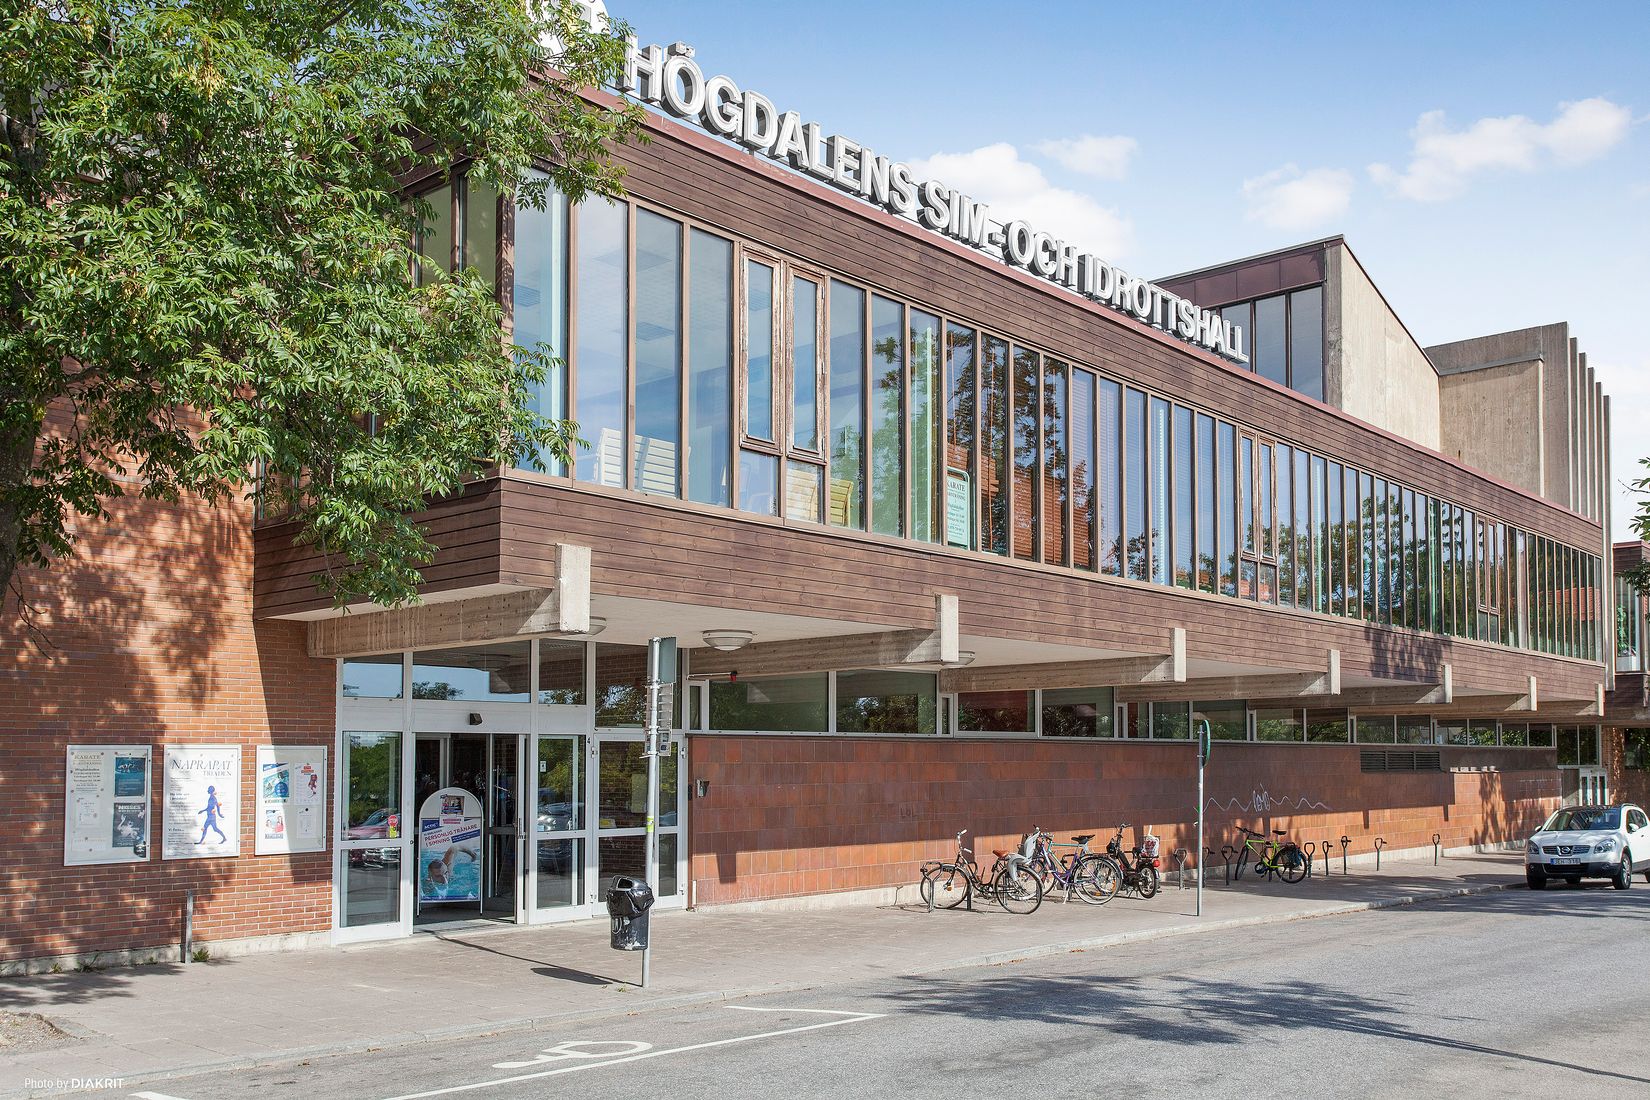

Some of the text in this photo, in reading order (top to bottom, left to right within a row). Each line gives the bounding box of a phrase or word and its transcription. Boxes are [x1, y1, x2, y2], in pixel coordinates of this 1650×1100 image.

[616, 34, 915, 213] HÖGDALENS
[1002, 219, 1077, 288] OCH
[1078, 253, 1249, 364] IDROTTSHALL
[171, 759, 233, 770] NAPRAPAT
[424, 830, 453, 841] PERSONLIG
